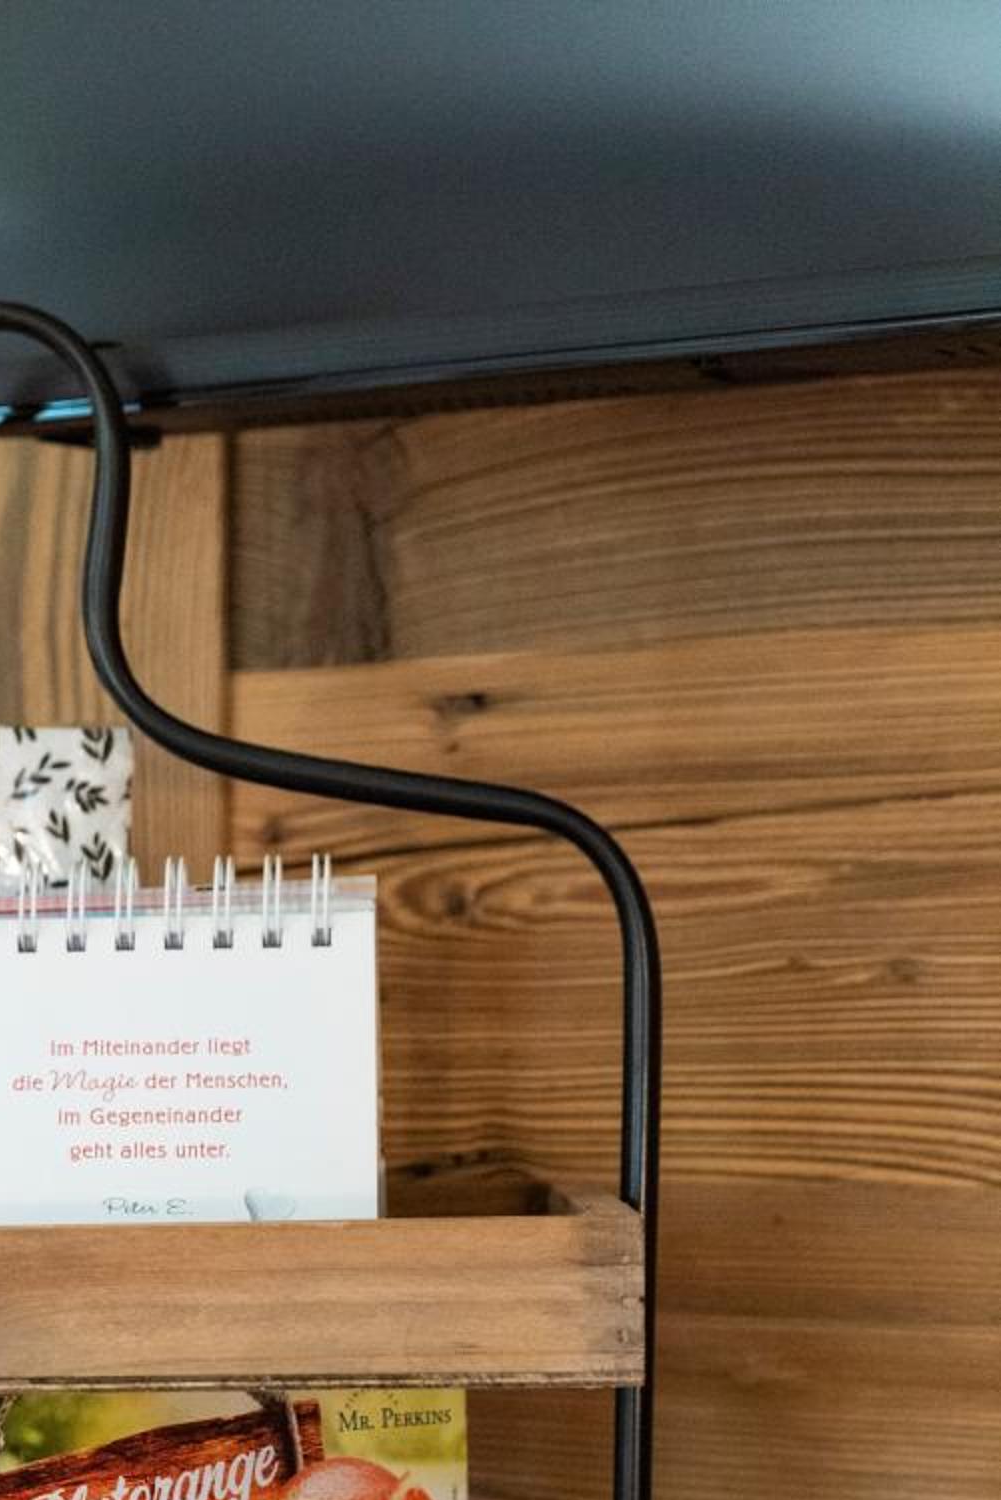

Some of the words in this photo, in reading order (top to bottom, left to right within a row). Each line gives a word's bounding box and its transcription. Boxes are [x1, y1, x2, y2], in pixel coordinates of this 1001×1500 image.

[83, 1039, 199, 1056] Miteinander
[208, 1037, 251, 1056] liegt
[12, 1073, 44, 1091] die
[50, 1070, 138, 1102] Magie
[144, 1071, 177, 1089] der
[185, 1071, 288, 1090] Menschen,
[90, 1106, 242, 1127] Gegeneinander
[70, 1142, 113, 1161] geht
[120, 1142, 167, 1159] alles
[176, 1141, 231, 1159] unter.
